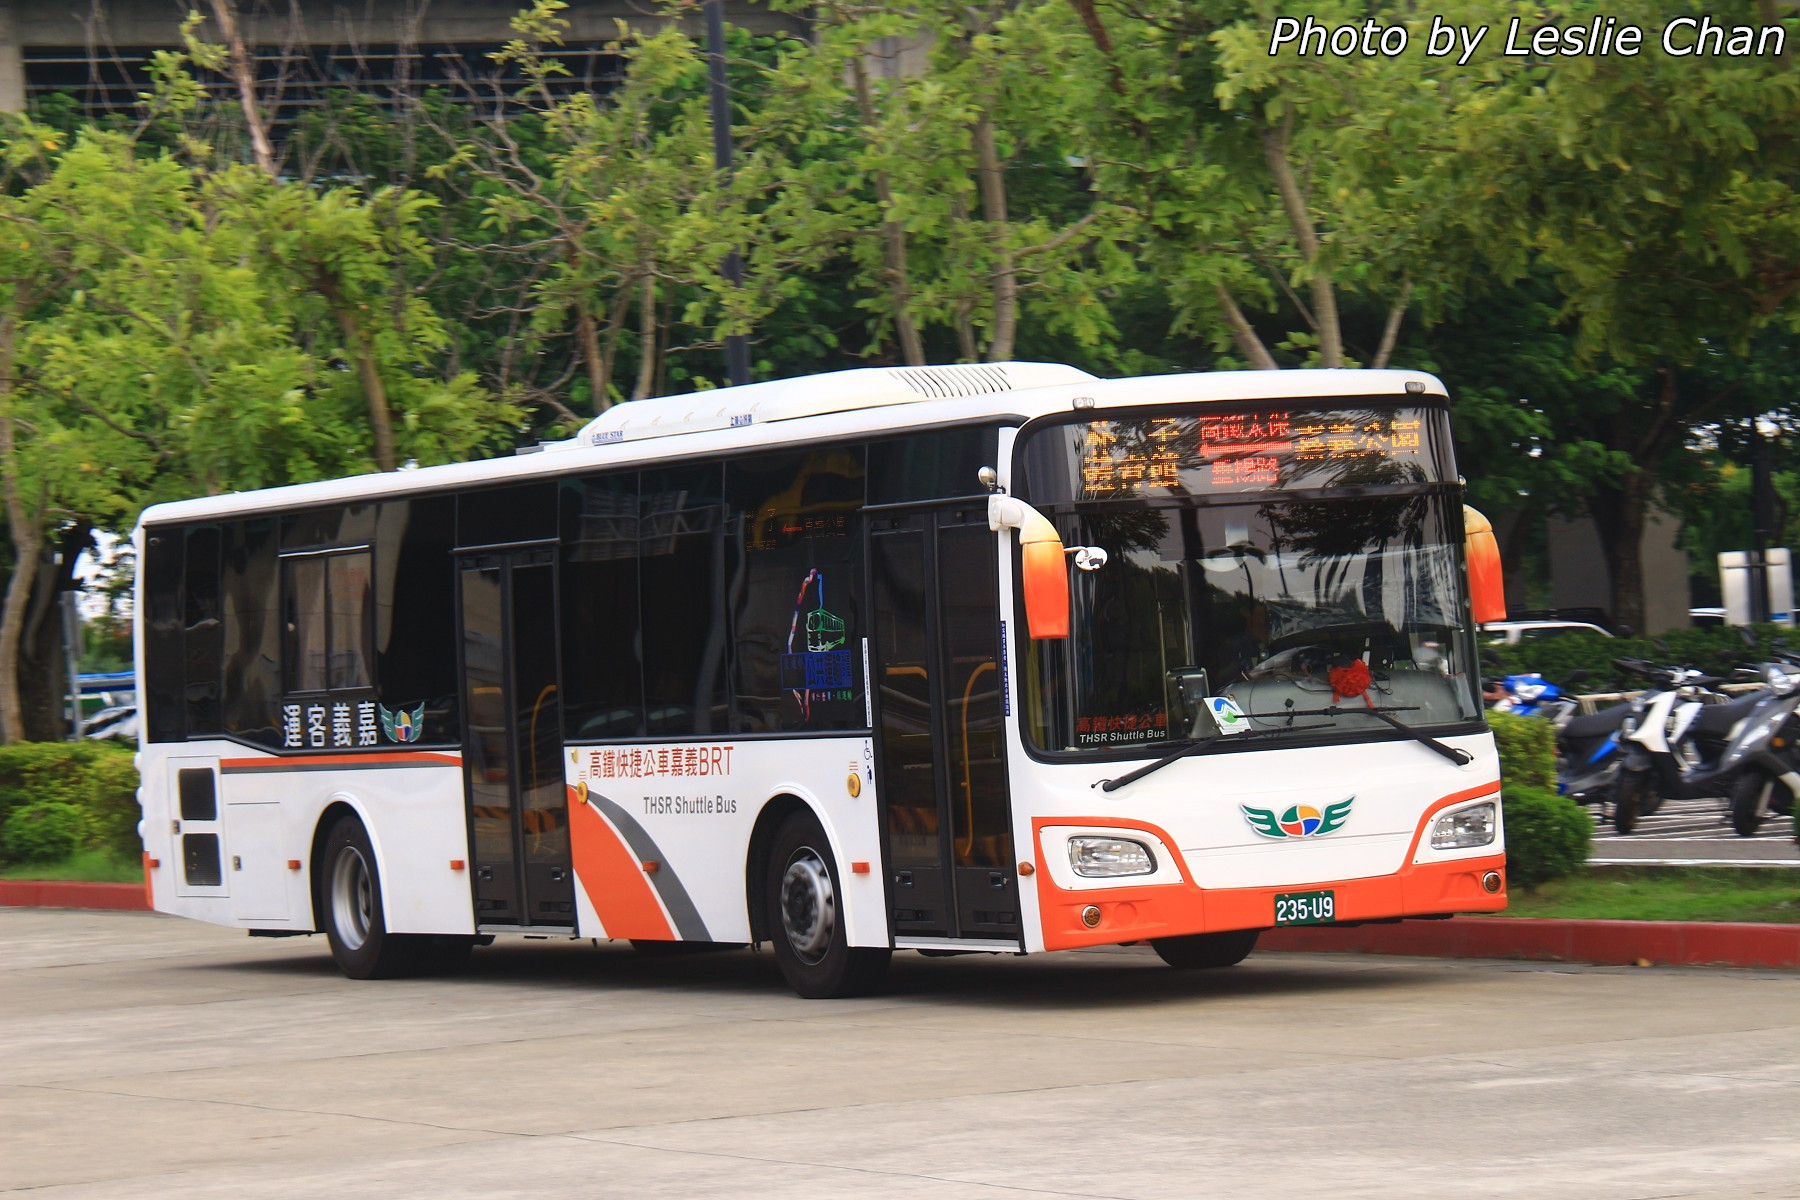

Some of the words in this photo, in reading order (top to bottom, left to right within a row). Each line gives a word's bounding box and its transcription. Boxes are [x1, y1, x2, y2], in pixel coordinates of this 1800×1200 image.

[1079, 733, 1108, 743] THSR
[1110, 730, 1145, 741] Shuttle
[1147, 729, 1166, 738] Bus
[643, 796, 673, 814] THSR
[675, 797, 713, 814] Shuttle
[716, 795, 737, 813] Bus
[1276, 896, 1333, 922] 235-U9
